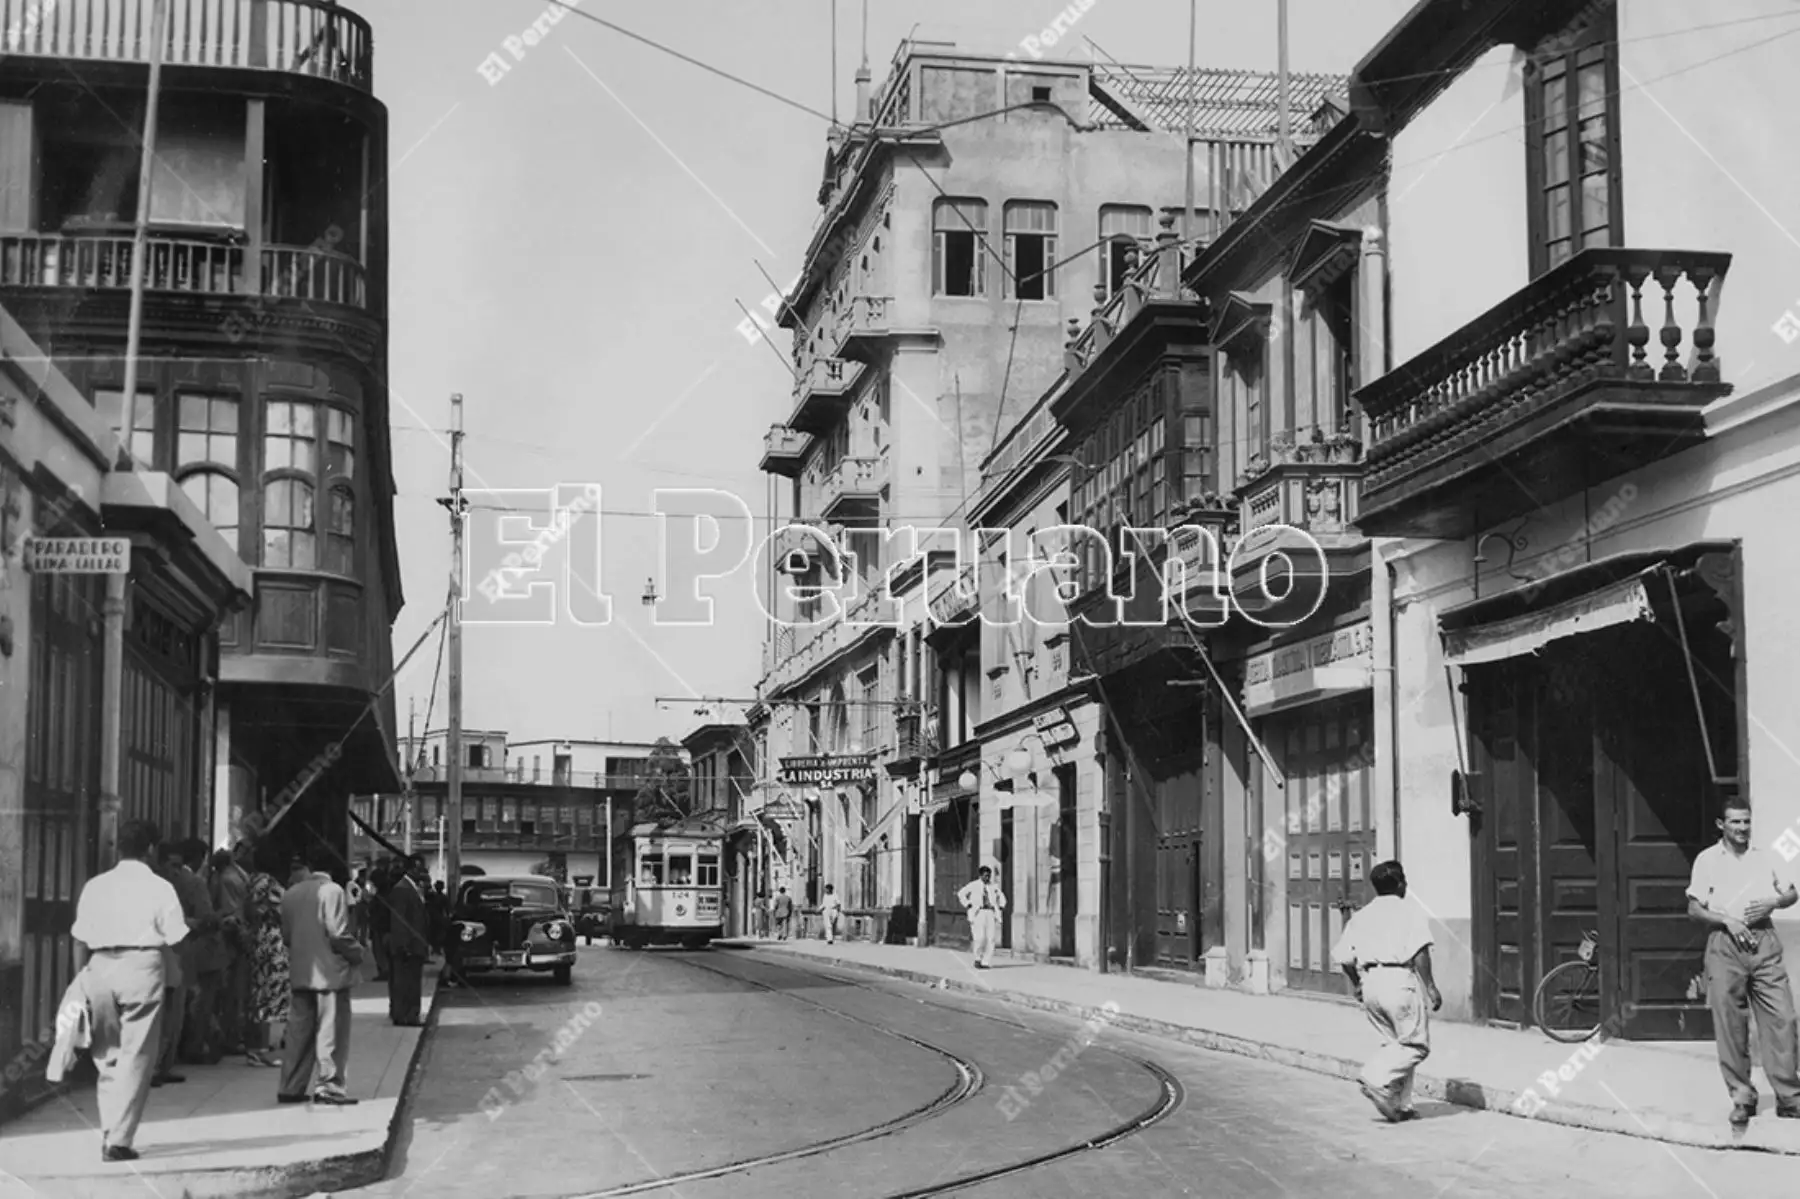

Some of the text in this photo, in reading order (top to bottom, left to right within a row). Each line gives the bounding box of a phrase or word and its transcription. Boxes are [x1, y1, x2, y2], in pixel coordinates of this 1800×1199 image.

[35, 541, 123, 555] PARADERO
[782, 768, 873, 783] LA INDUSTRIA
